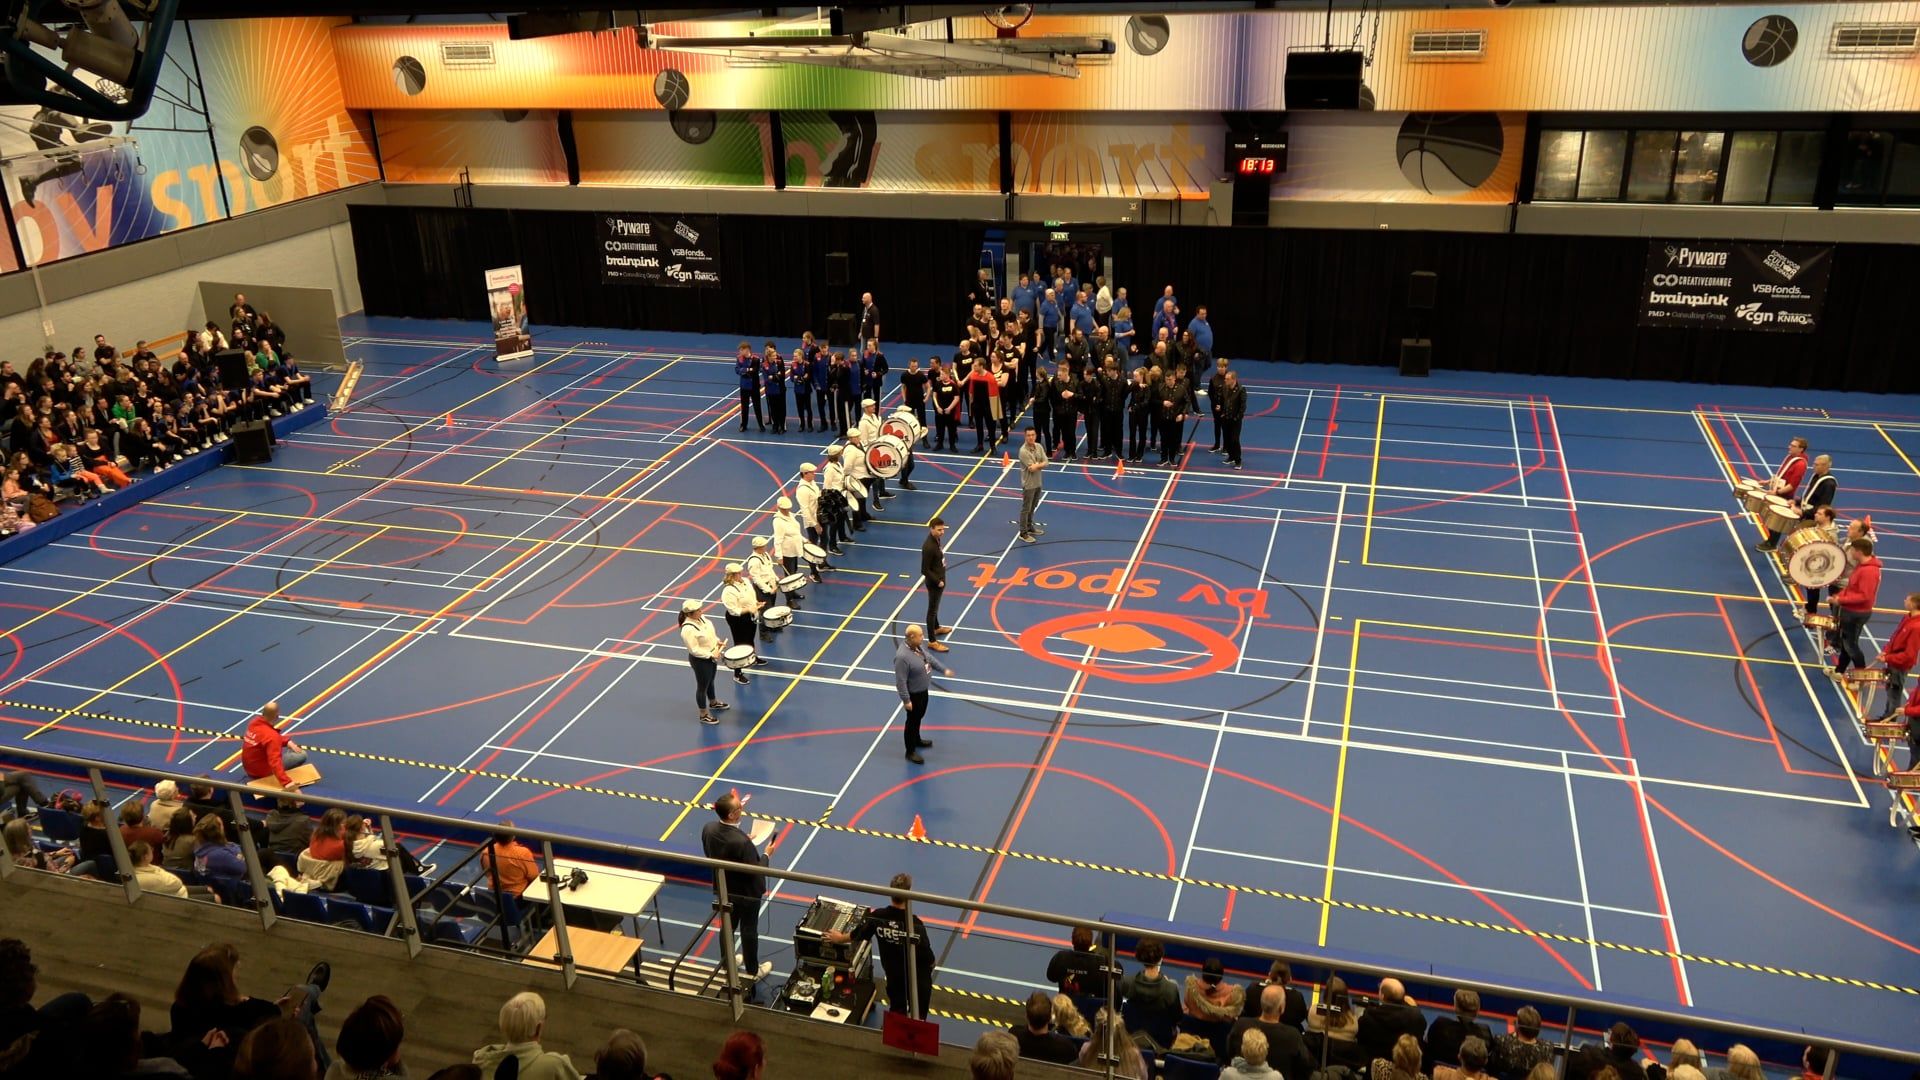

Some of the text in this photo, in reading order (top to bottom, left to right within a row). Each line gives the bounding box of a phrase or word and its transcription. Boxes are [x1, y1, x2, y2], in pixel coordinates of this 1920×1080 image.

[1241, 159, 1274, 171] 18:13
[616, 219, 650, 236] Pyware
[605, 255, 660, 268] brainpink
[1679, 247, 1728, 267] Pyware
[673, 271, 692, 282] cgn
[1649, 291, 1729, 307] brainpink
[1745, 311, 1774, 325] cgn
[1777, 315, 1806, 324] KNMO
[967, 562, 1272, 619] bv sport
